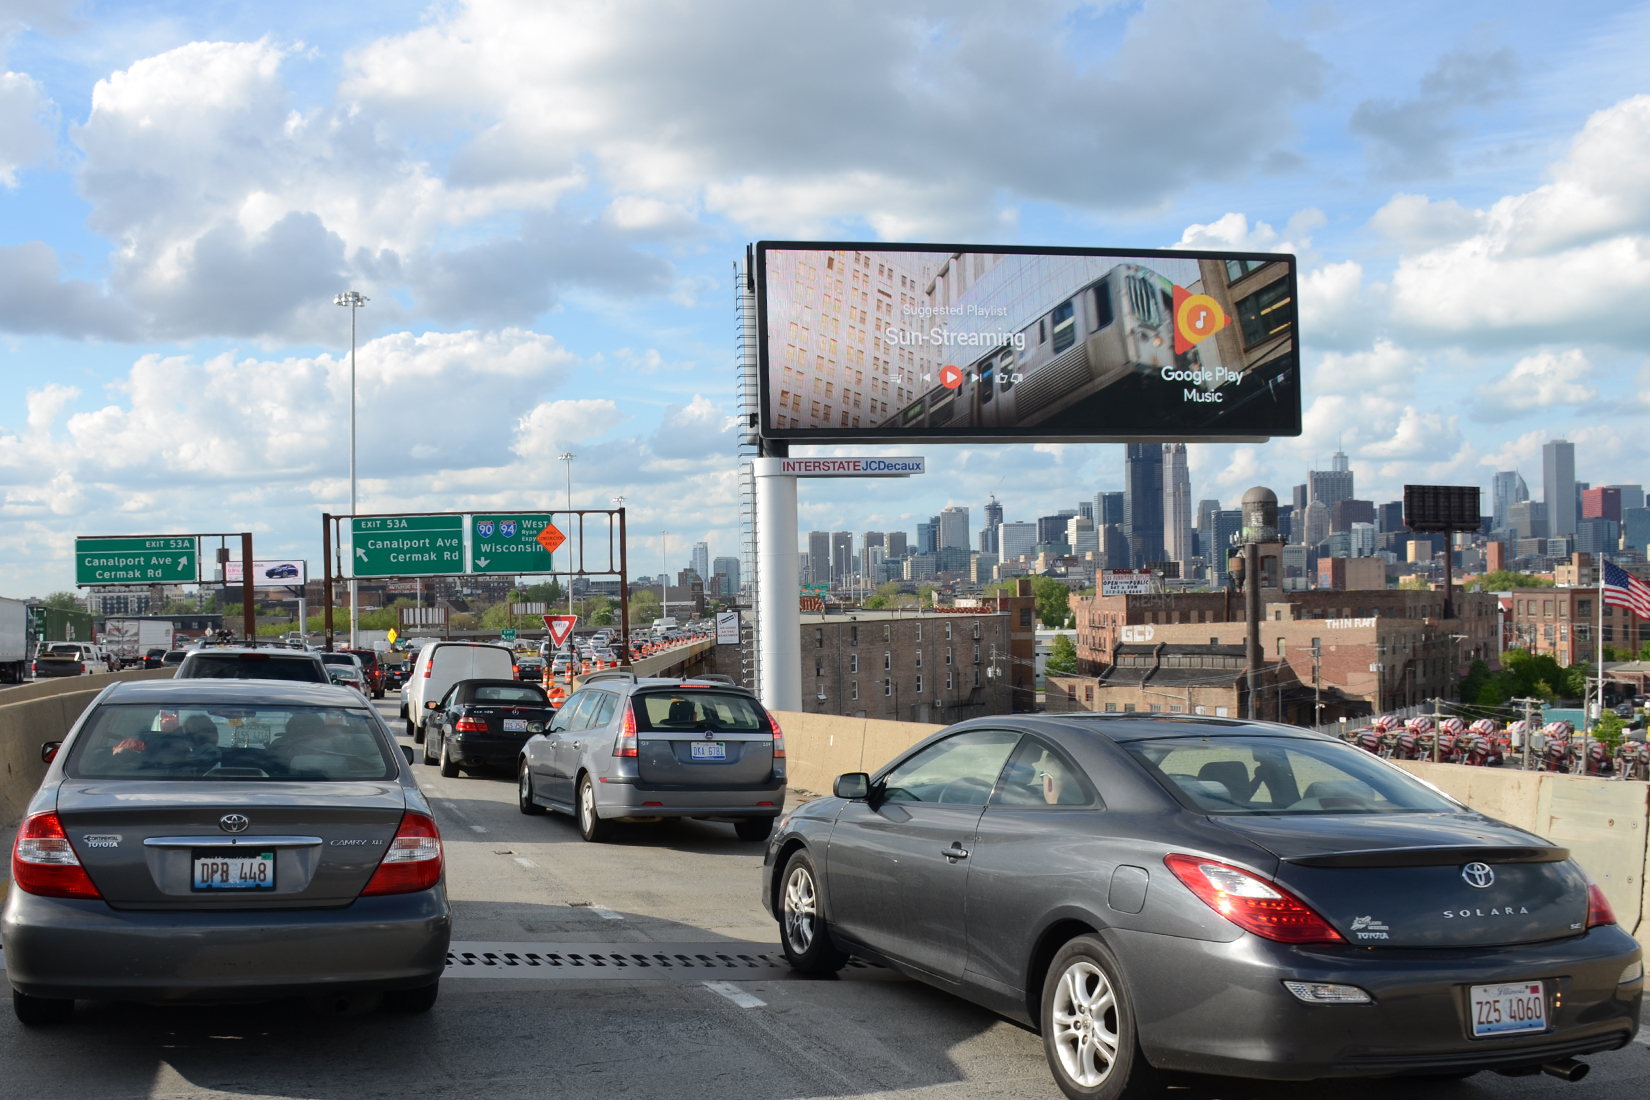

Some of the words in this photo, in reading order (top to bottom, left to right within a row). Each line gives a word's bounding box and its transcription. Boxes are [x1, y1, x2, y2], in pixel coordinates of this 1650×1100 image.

[902, 304, 963, 318] Suggested
[966, 304, 1008, 318] Playlist
[885, 327, 1026, 351] Sun-Streaming
[1161, 365, 1213, 386] Google
[1215, 367, 1244, 386] Play
[1183, 388, 1223, 403] Music
[387, 520, 408, 528] 53A
[479, 525, 493, 534] 90
[500, 524, 515, 534] 94
[521, 520, 548, 528] WEST
[170, 540, 190, 548] 53A
[368, 538, 430, 550] Canalport
[436, 537, 459, 547] Ave
[480, 543, 544, 553] Wisconsin
[84, 556, 145, 568] Canalport
[151, 555, 172, 565] Ave
[390, 552, 437, 563] Cermak
[444, 551, 459, 561] Rd
[95, 570, 143, 579] Cermak
[147, 569, 162, 578] Rd
[1325, 618, 1352, 629] THIN
[239, 862, 267, 882] 448
[1443, 906, 1529, 919] SOLARA
[1356, 932, 1389, 940] TOYOTA
[1497, 986, 1526, 996] Illinois
[1509, 997, 1542, 1021] 4060
